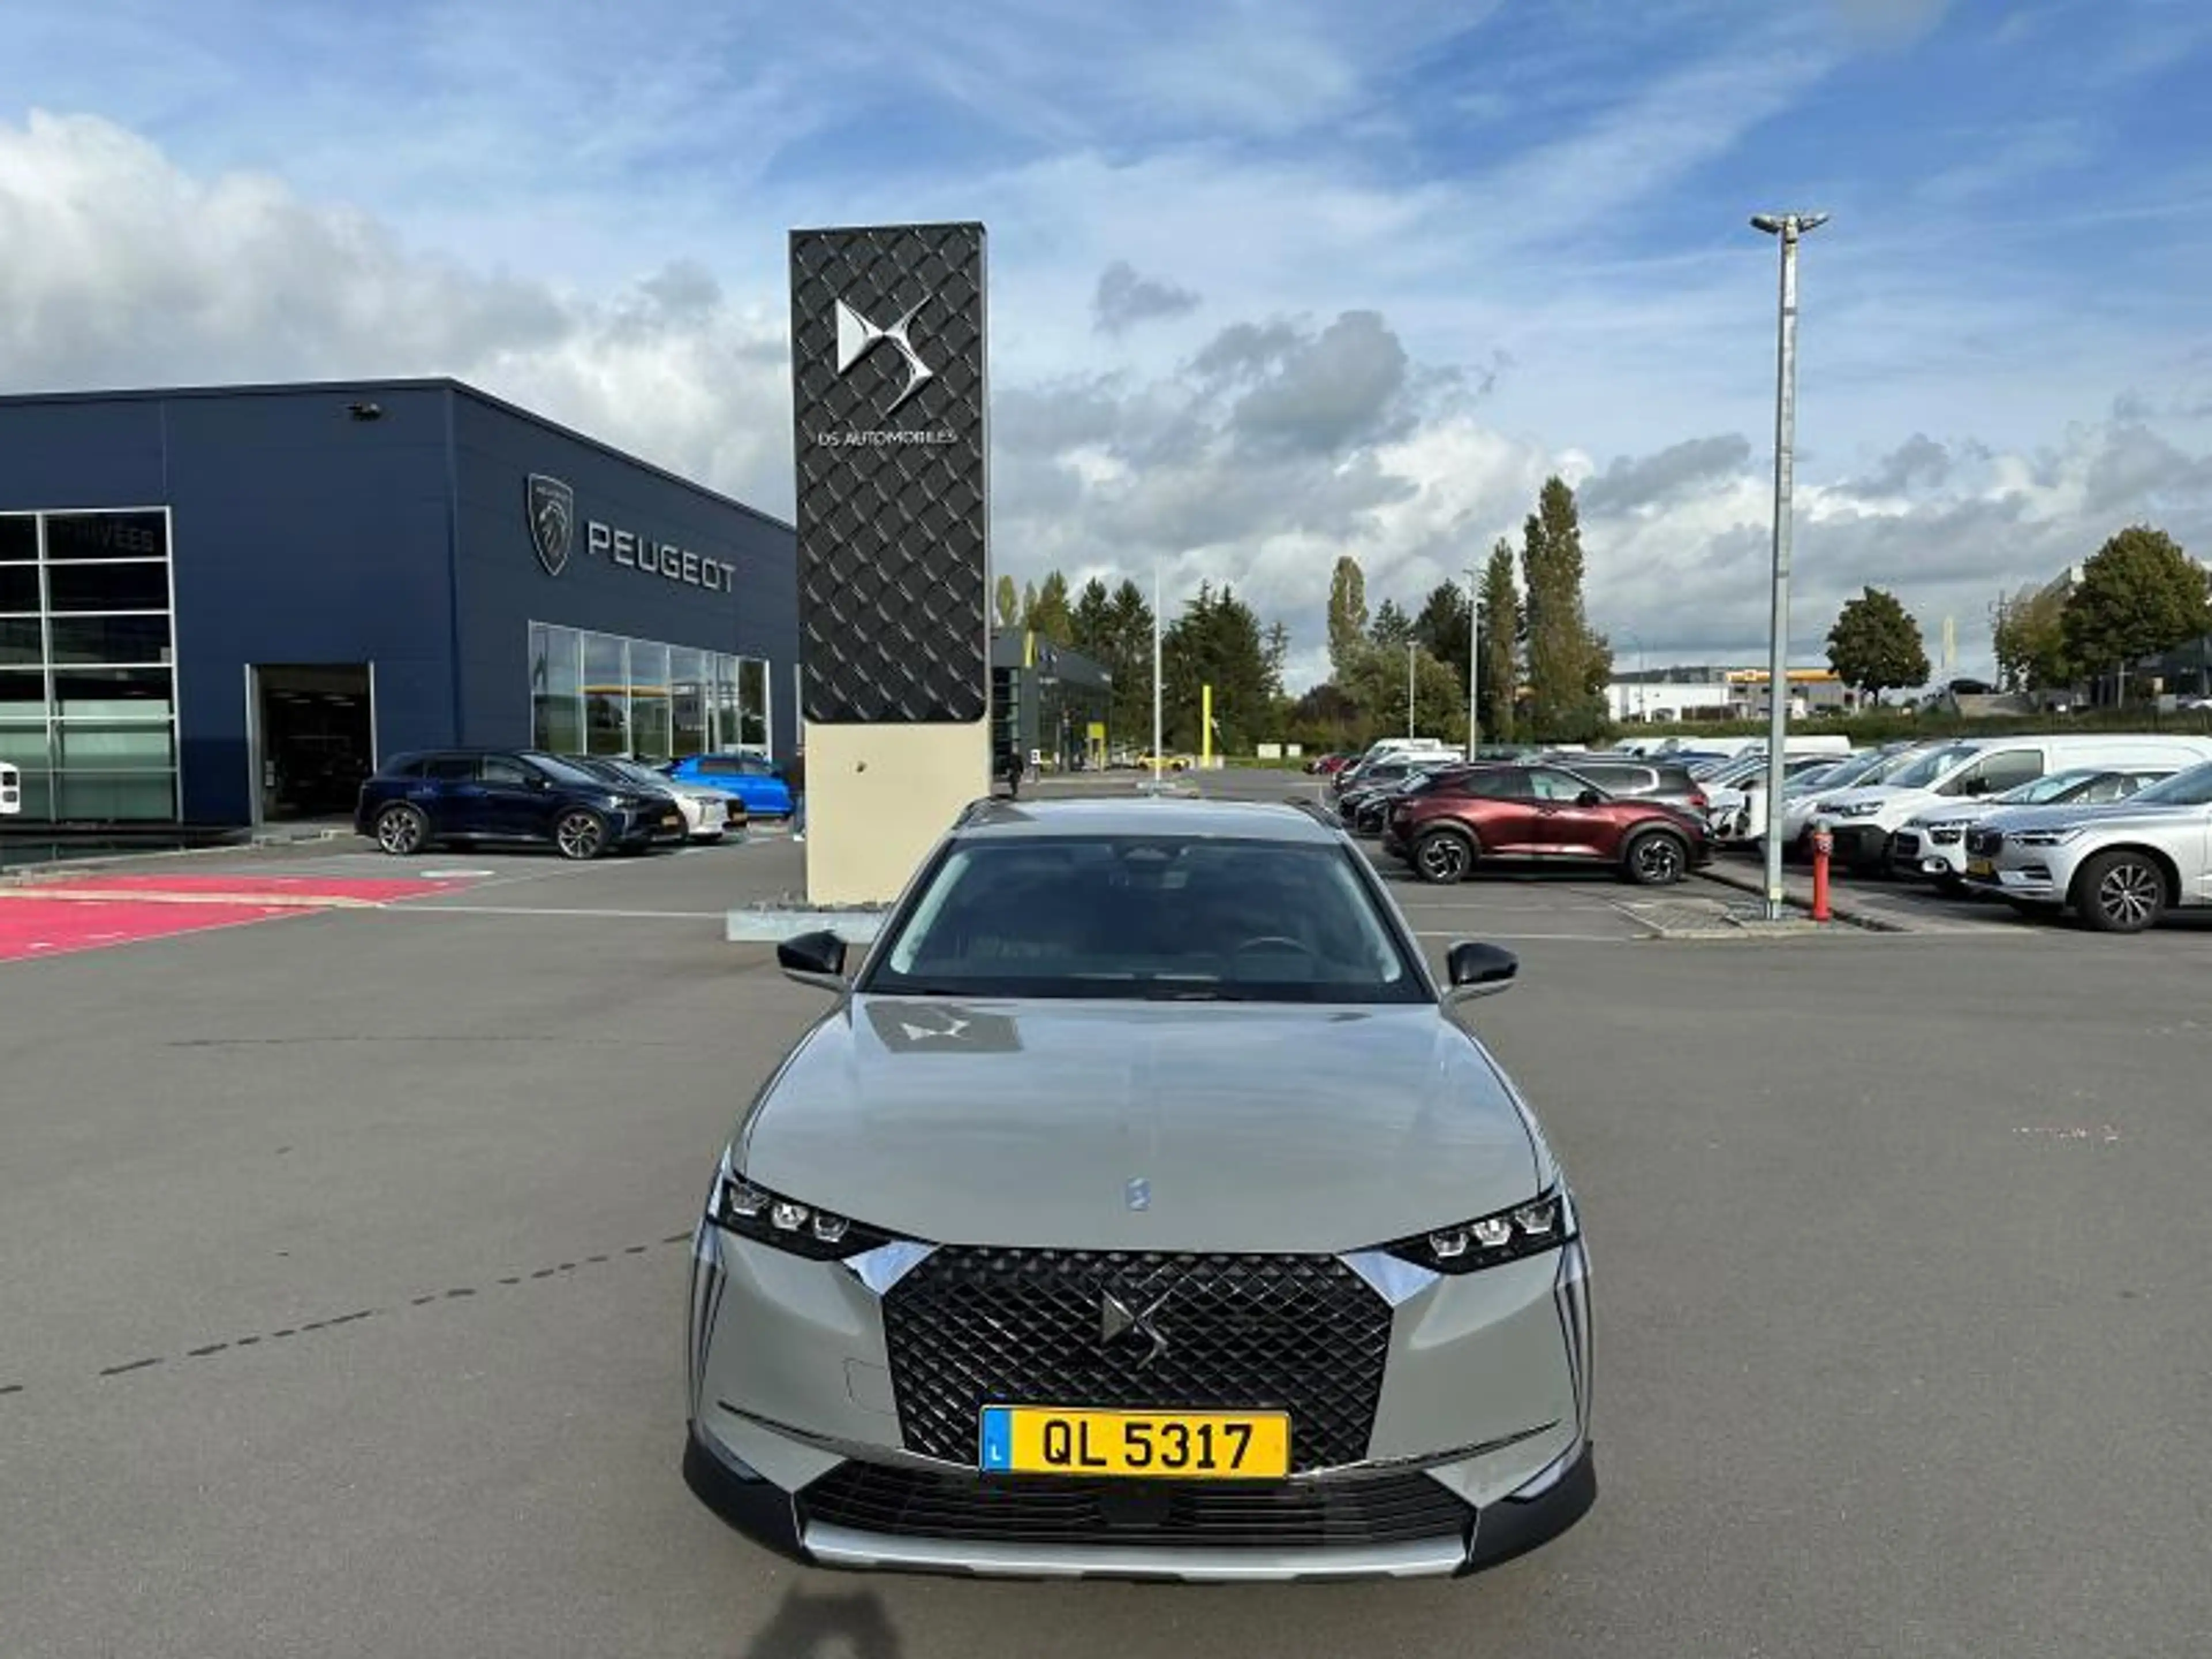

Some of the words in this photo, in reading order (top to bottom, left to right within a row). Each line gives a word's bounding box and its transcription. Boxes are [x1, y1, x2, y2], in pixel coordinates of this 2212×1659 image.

[817, 431, 839, 446] DS
[843, 430, 958, 446] AUTOMOBILES
[588, 520, 737, 593] PEUGEOT
[990, 1445, 1002, 1461] L
[1044, 1420, 1107, 1465] QL
[1124, 1423, 1253, 1469] 5317
